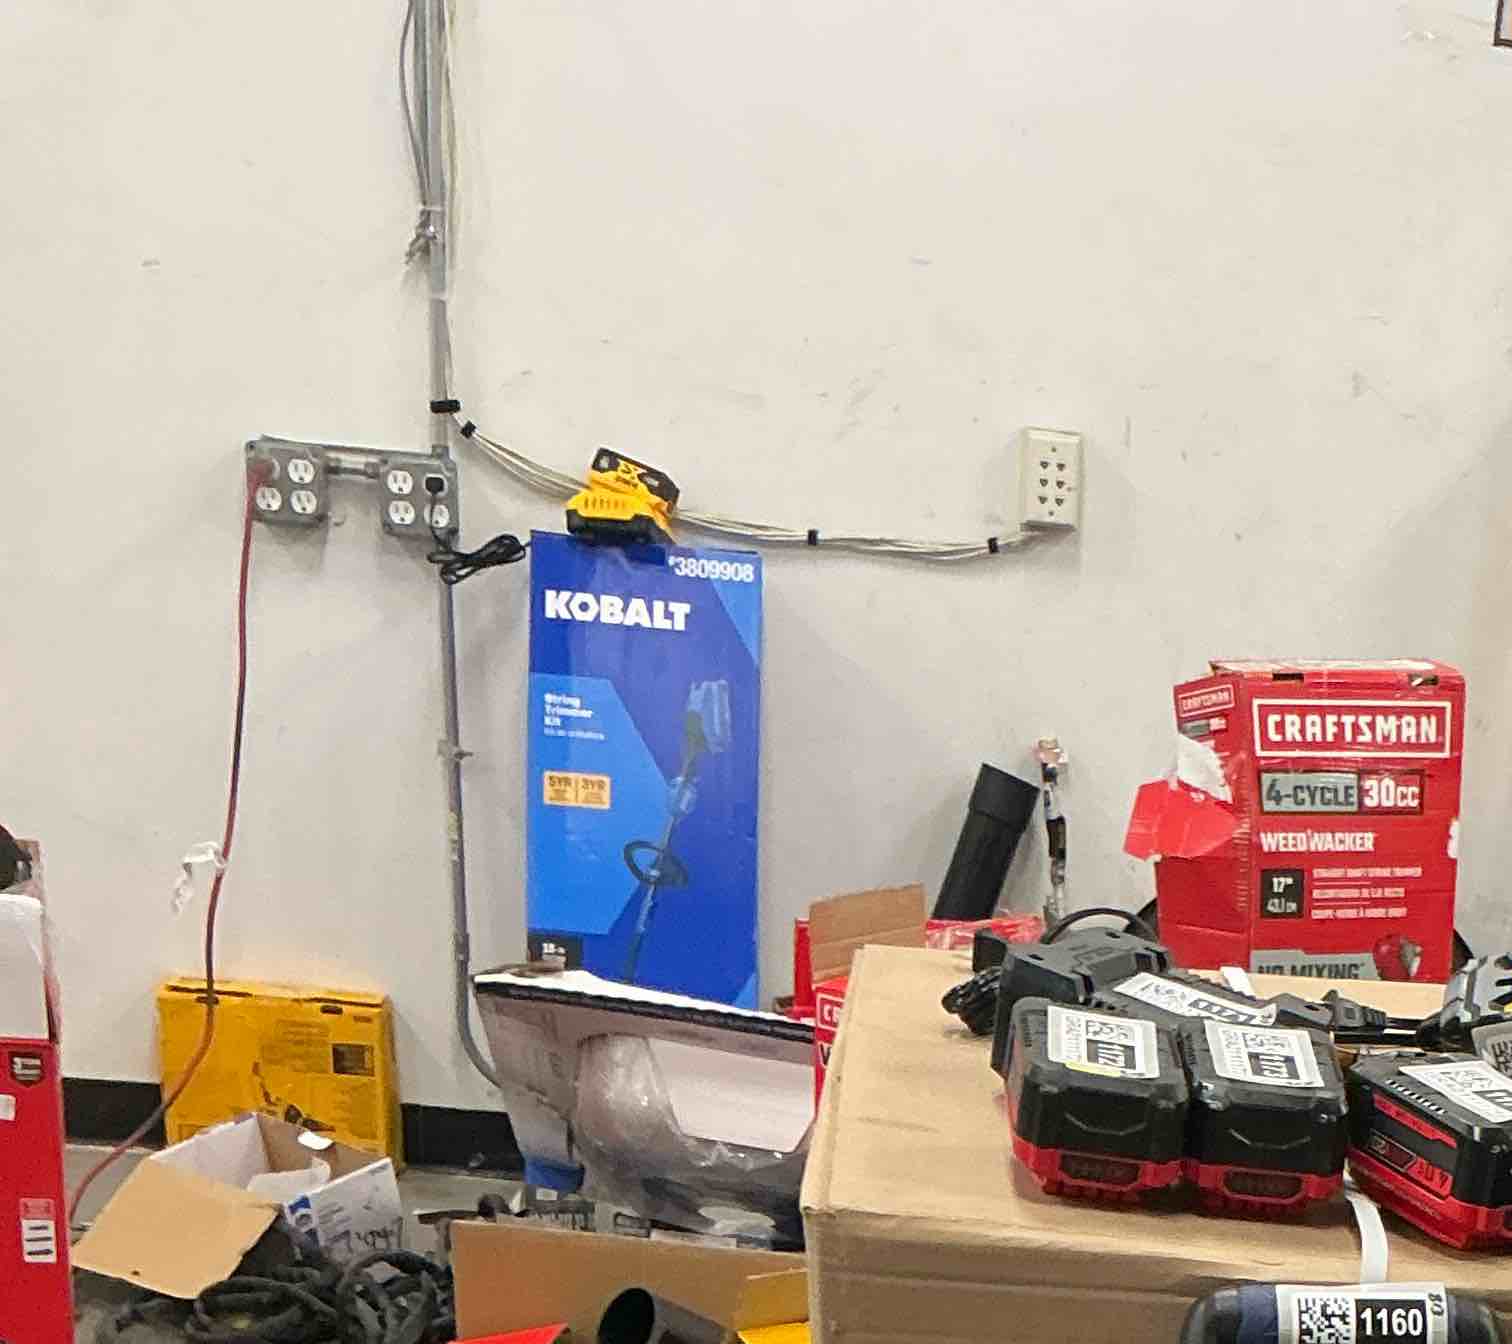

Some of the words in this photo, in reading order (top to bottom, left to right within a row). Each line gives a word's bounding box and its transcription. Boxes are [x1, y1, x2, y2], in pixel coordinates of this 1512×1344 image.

[544, 589, 691, 631] KOBALT
[1267, 714, 1439, 743] CRAFTSMAN
[1265, 778, 1355, 807] 4-CYCLE
[1360, 1308, 1423, 1336] 1160
